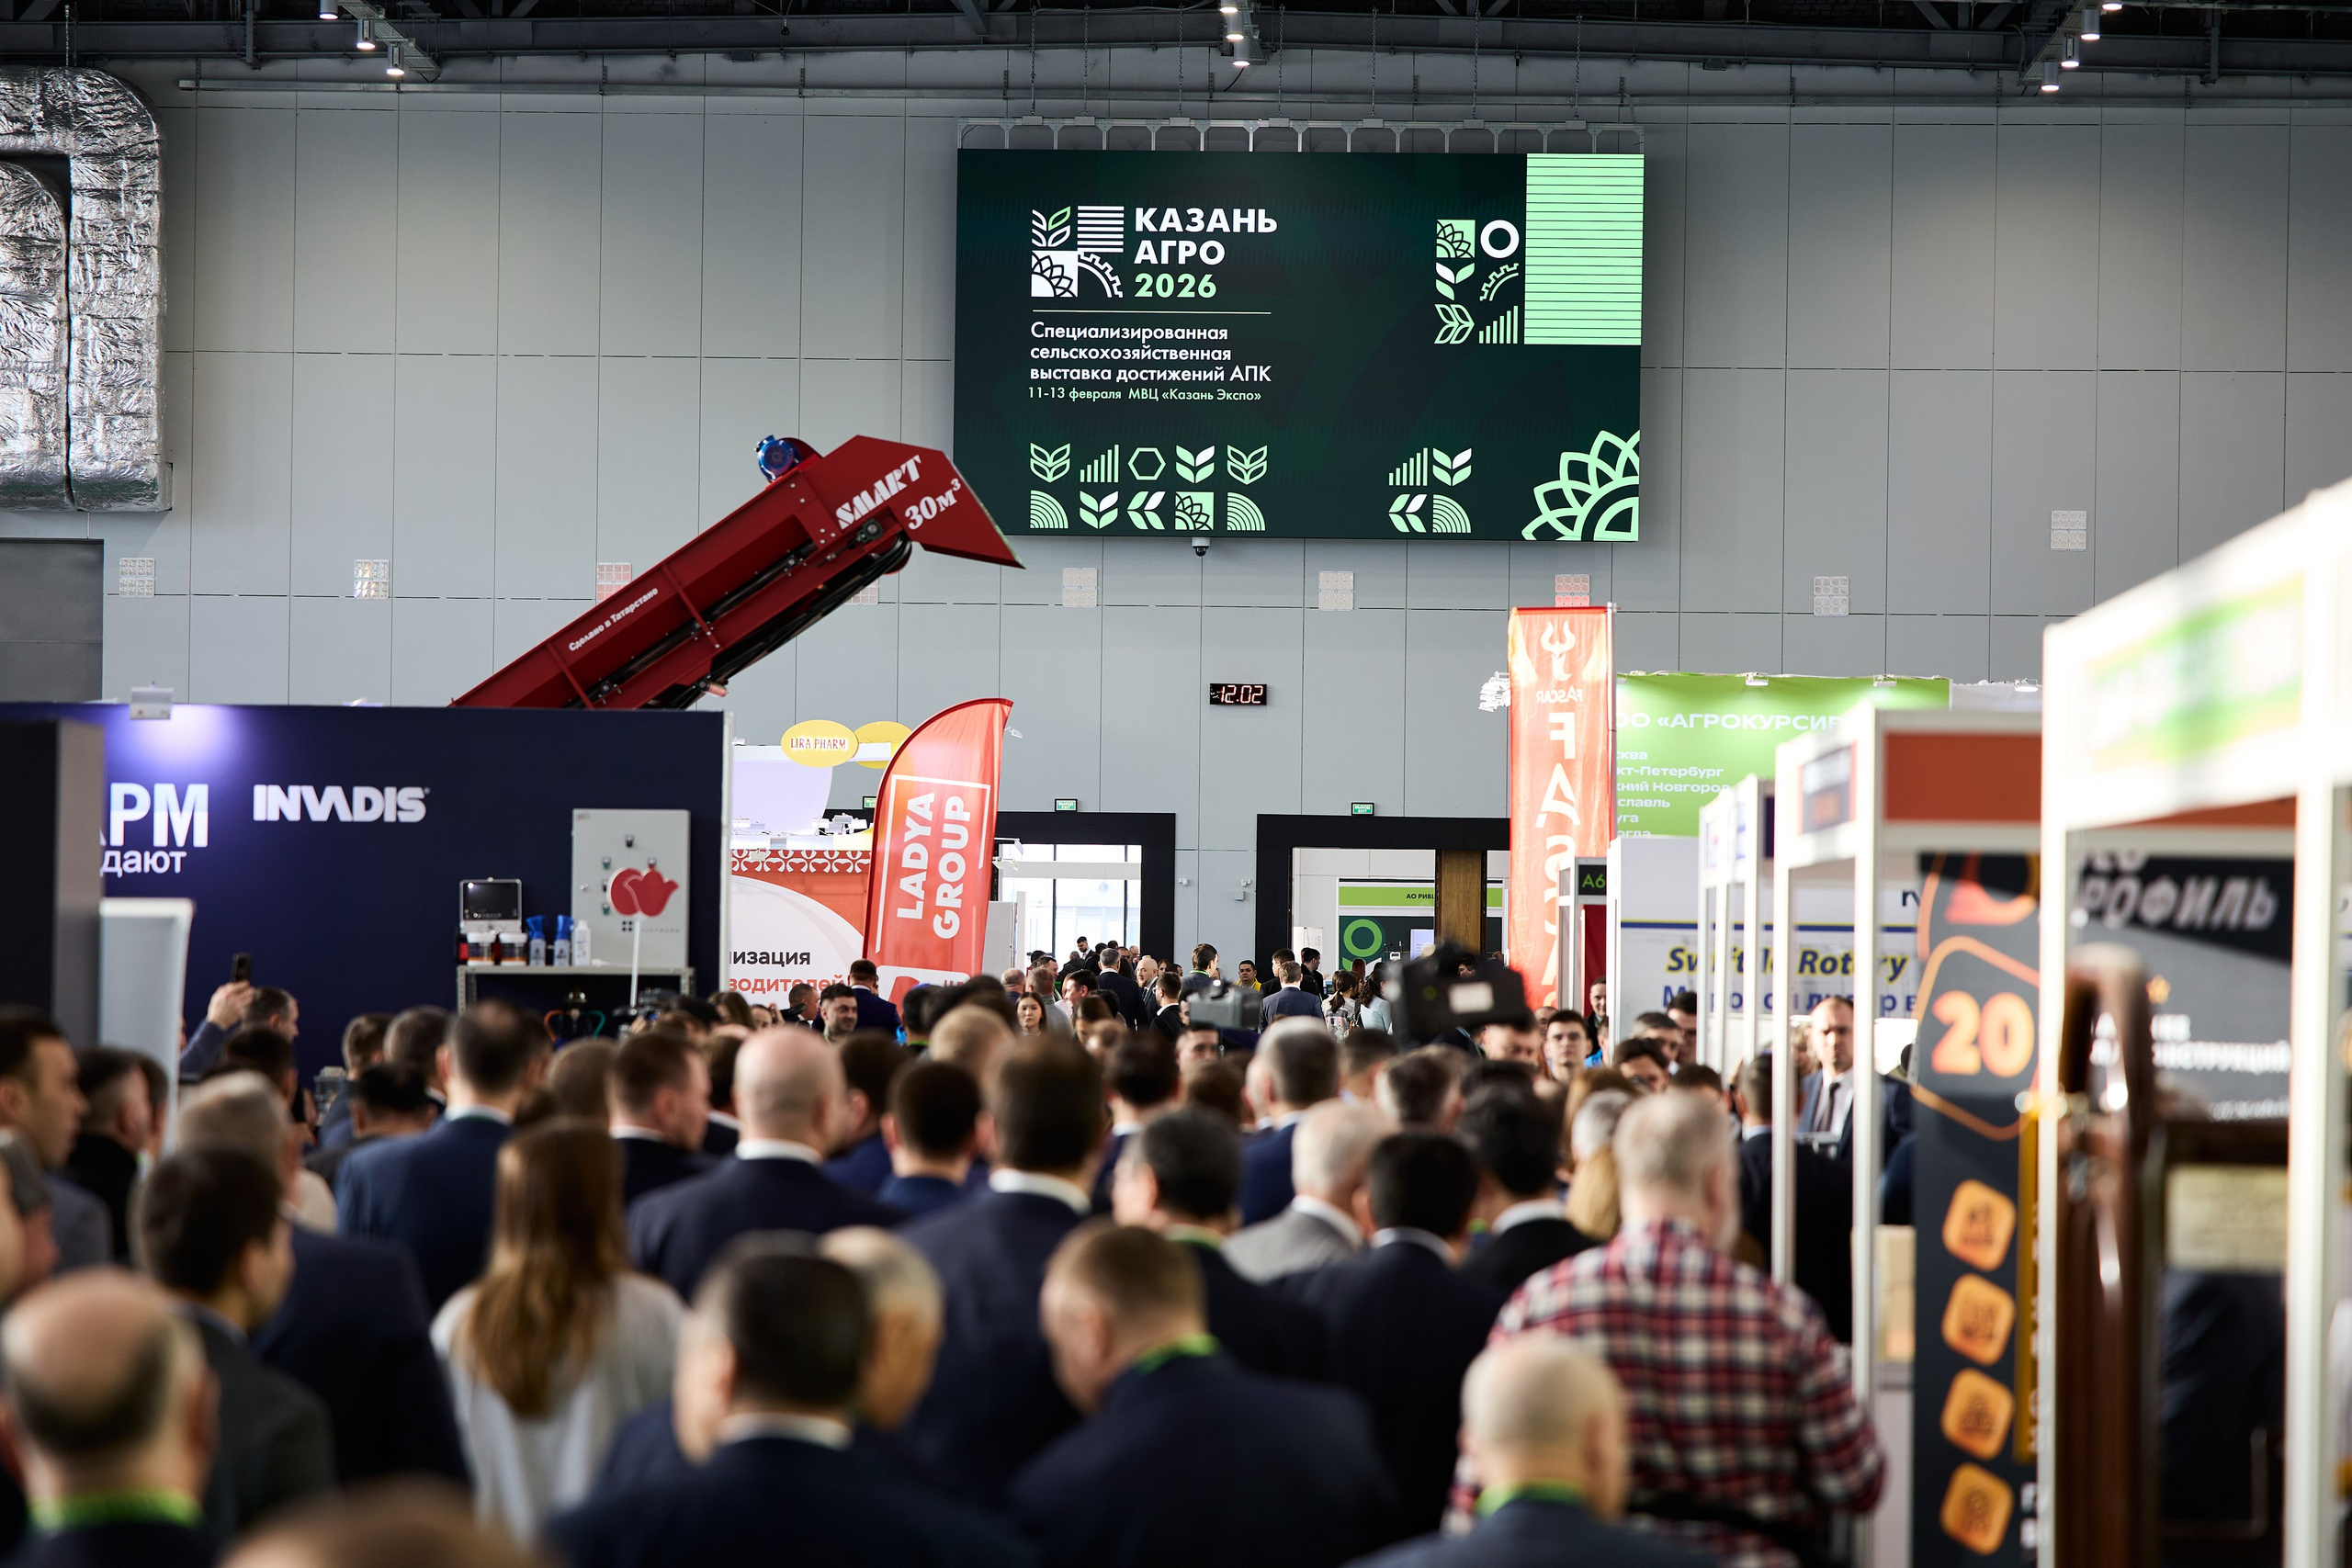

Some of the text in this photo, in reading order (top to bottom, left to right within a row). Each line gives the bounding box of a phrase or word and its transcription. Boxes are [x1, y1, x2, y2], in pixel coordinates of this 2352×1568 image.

[1135, 207, 1278, 233] КАЗАНЬ
[1133, 240, 1226, 265] АГРО
[1134, 273, 1216, 299] 2026
[1030, 321, 1228, 344] Специализированная
[1030, 344, 1231, 360] сельскохозяйственная
[1030, 366, 1272, 383] выставка достижений АПК
[1028, 387, 1261, 402] 11-13 февраля МВЦ «Казань Экспо»
[835, 454, 922, 530] SMART
[569, 588, 659, 651] Сделано в Татарстане
[790, 739, 846, 750] LIRA PHARM
[99, 783, 209, 848] РМ
[897, 792, 935, 919] LADYA
[933, 795, 971, 939] GROUP
[729, 951, 810, 967] изация
[1798, 950, 1907, 984] Roty
[1930, 989, 2035, 1077] 20
